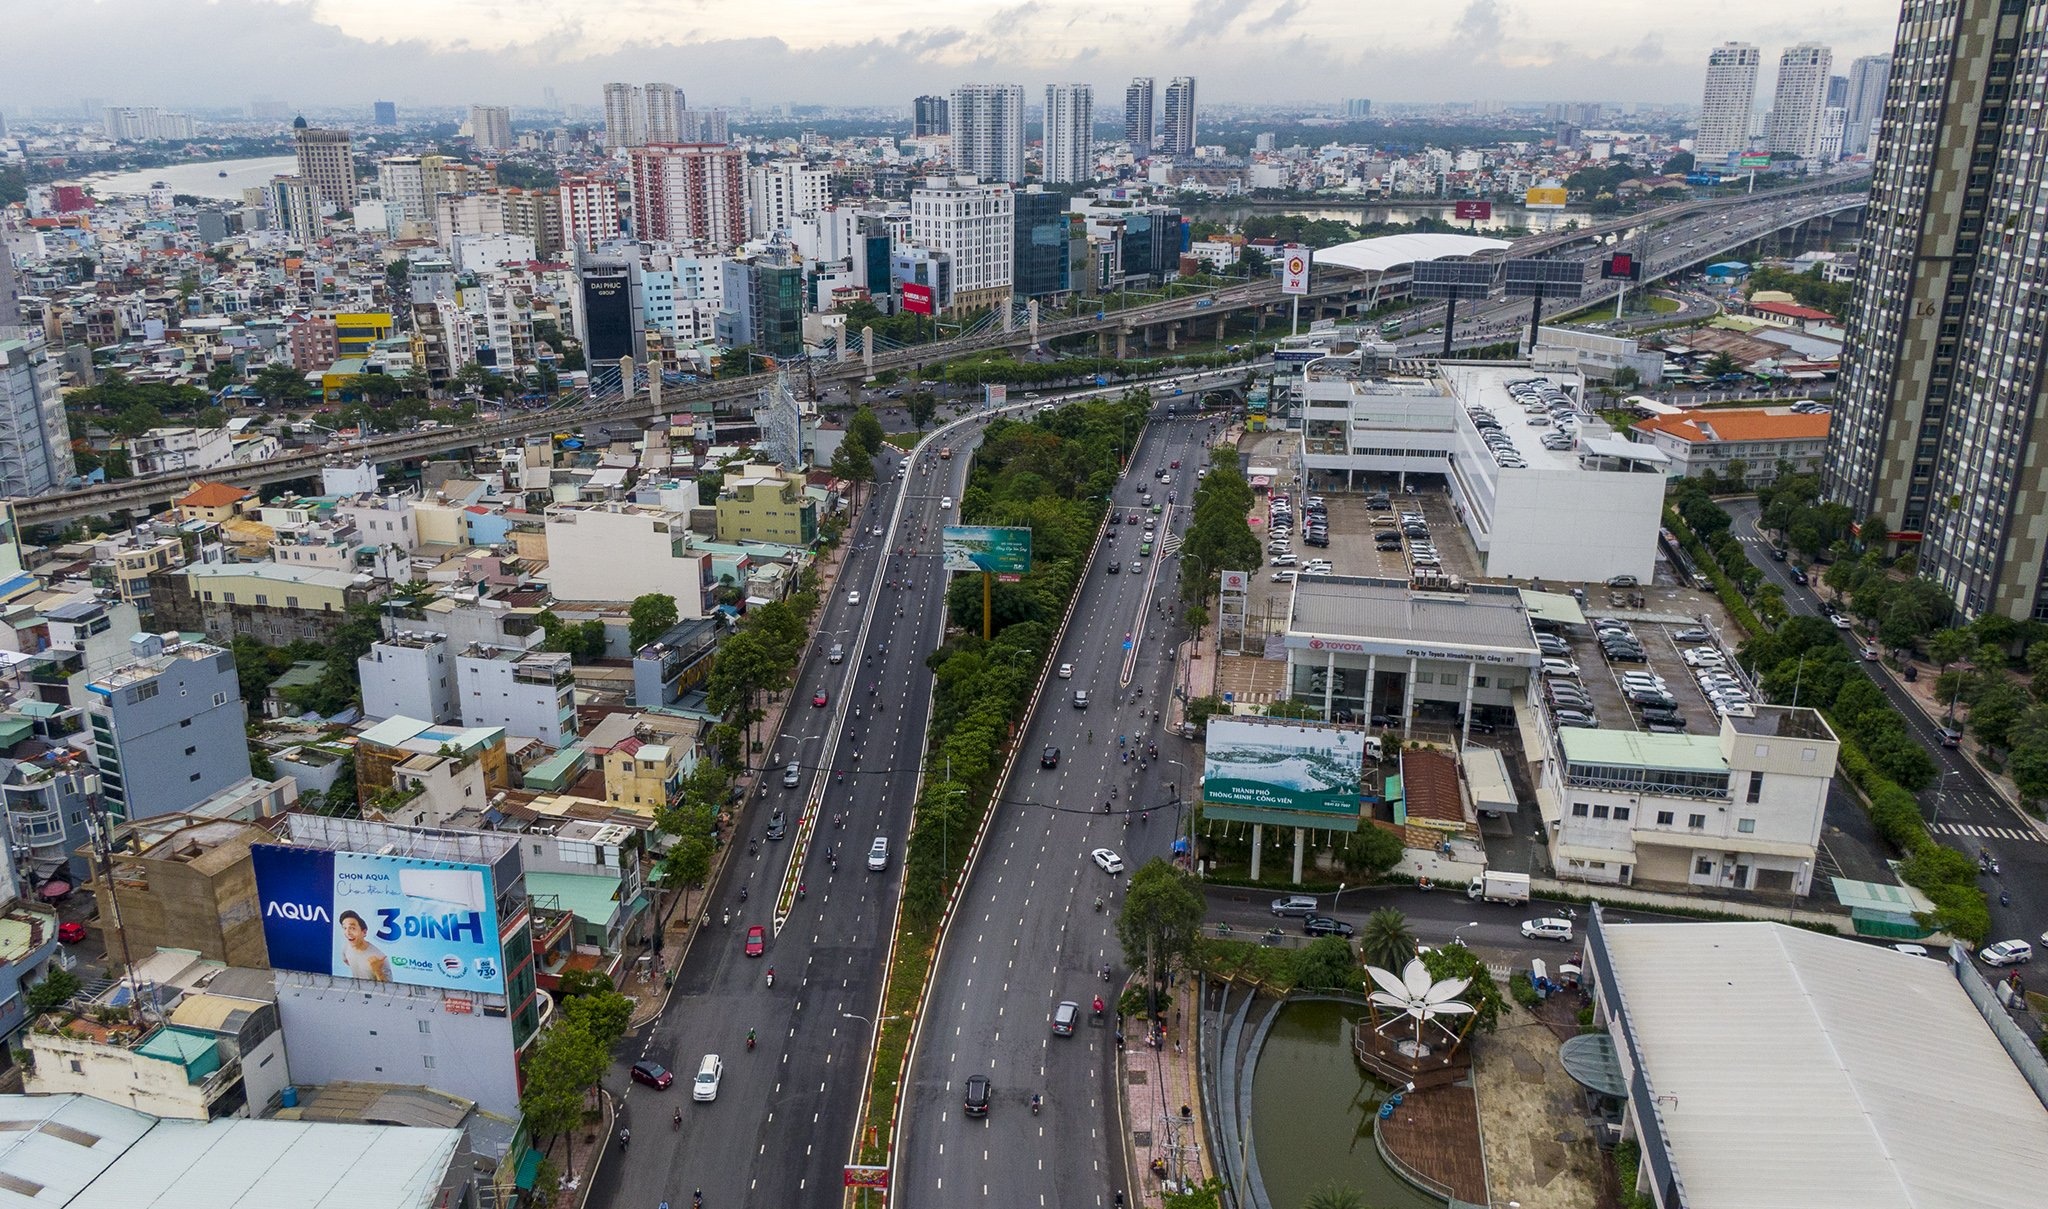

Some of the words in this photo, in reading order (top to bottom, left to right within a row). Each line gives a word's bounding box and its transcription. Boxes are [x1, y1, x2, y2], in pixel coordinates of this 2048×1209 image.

[1916, 302, 1936, 316] L6
[1325, 642, 1364, 651] TOYOTA
[267, 901, 330, 922] AQUA
[376, 908, 402, 942] 3
[392, 956, 408, 966] ECO
[409, 959, 432, 968] Mode
[478, 968, 496, 976] 730
